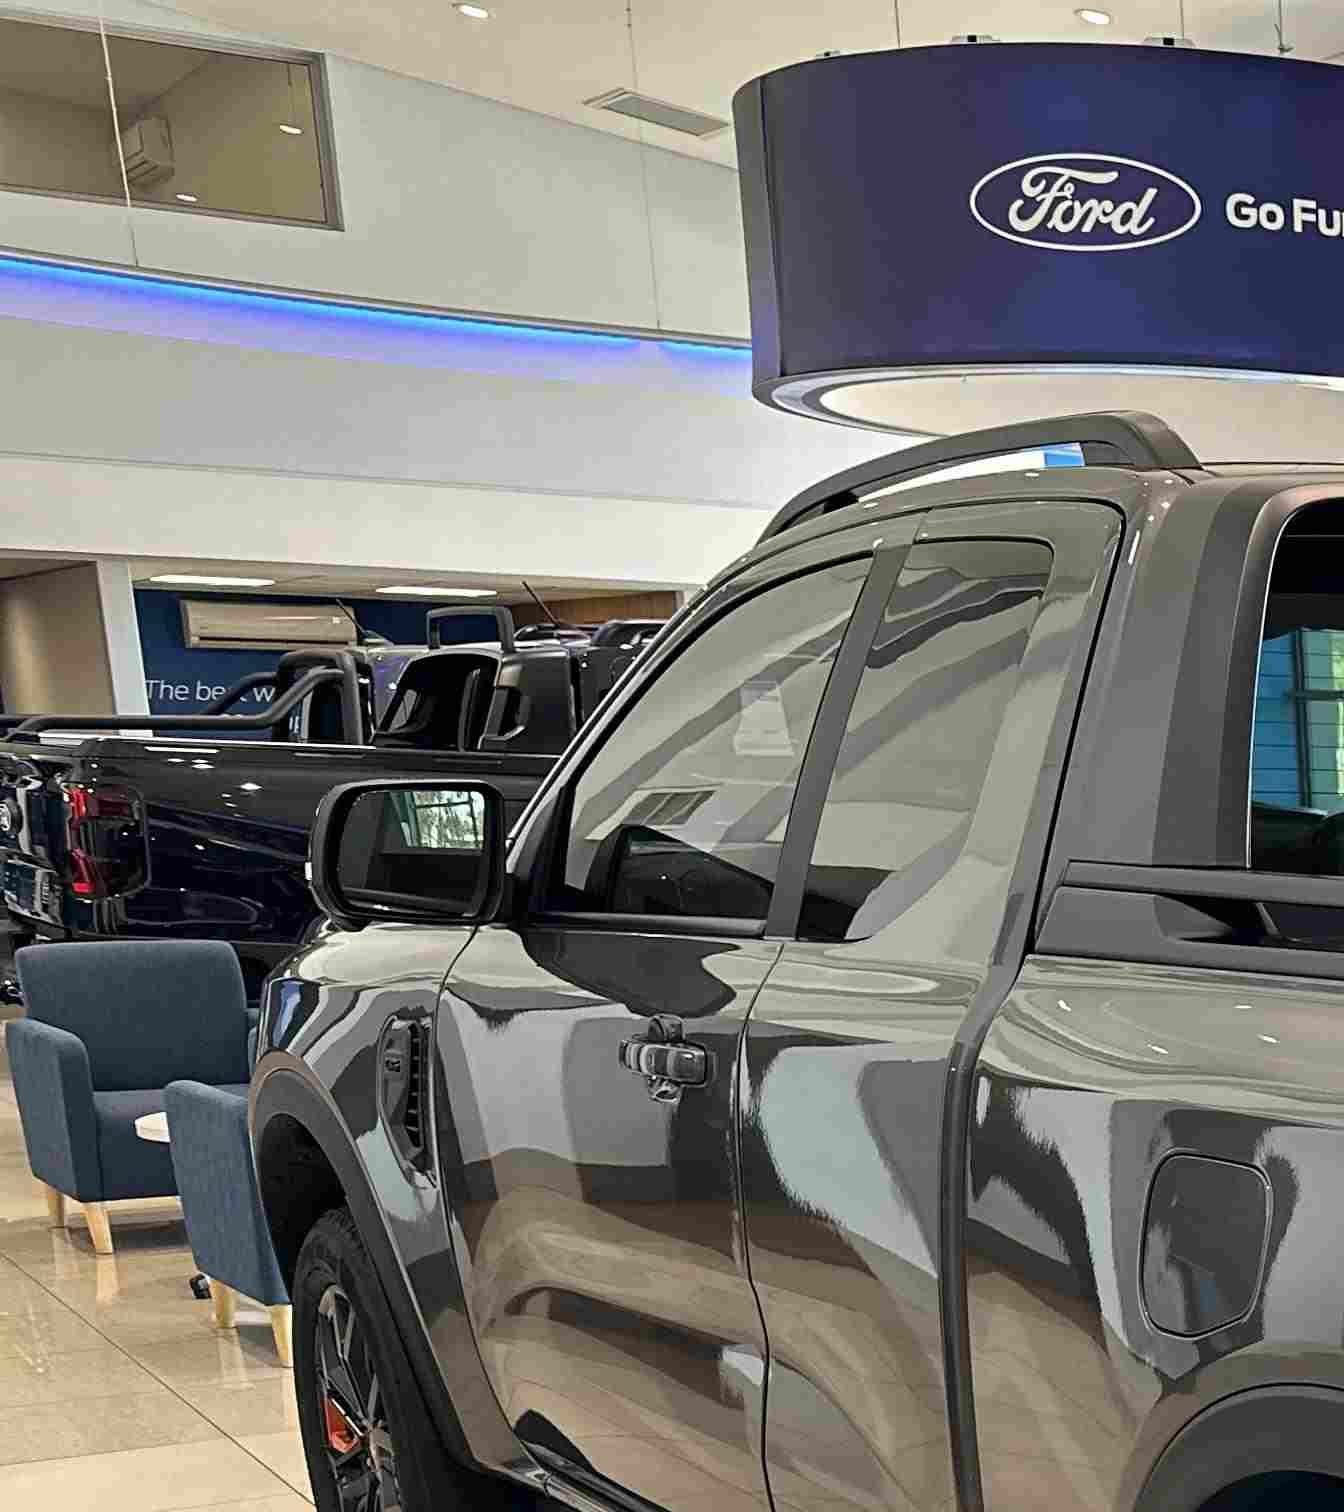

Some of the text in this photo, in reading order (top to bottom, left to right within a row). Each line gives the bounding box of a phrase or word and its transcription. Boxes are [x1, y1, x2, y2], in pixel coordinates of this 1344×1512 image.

[1007, 165, 1158, 236] Ford
[1224, 192, 1286, 232] Go
[144, 679, 190, 701] The
[196, 680, 247, 702] be
